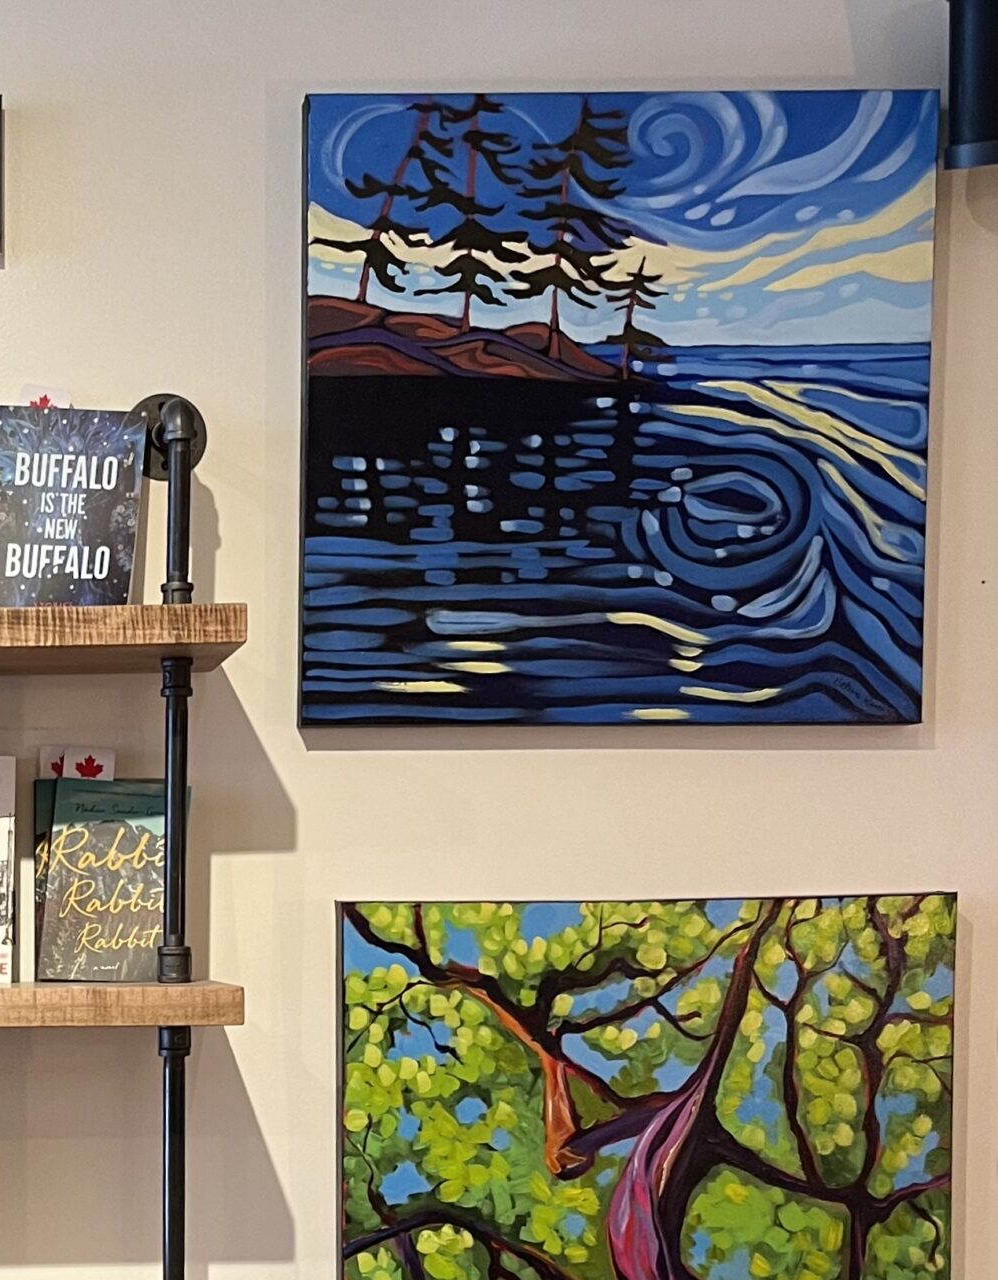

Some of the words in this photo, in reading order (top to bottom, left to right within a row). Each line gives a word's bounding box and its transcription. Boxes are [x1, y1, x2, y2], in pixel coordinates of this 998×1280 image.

[14, 452, 119, 490] BUFFALO
[40, 492, 54, 514] IS
[57, 492, 86, 515] THE
[44, 518, 78, 540] NEW
[5, 543, 110, 579] BUFFALO
[50, 826, 165, 876] Rabbi
[74, 921, 164, 954] Rabbit
